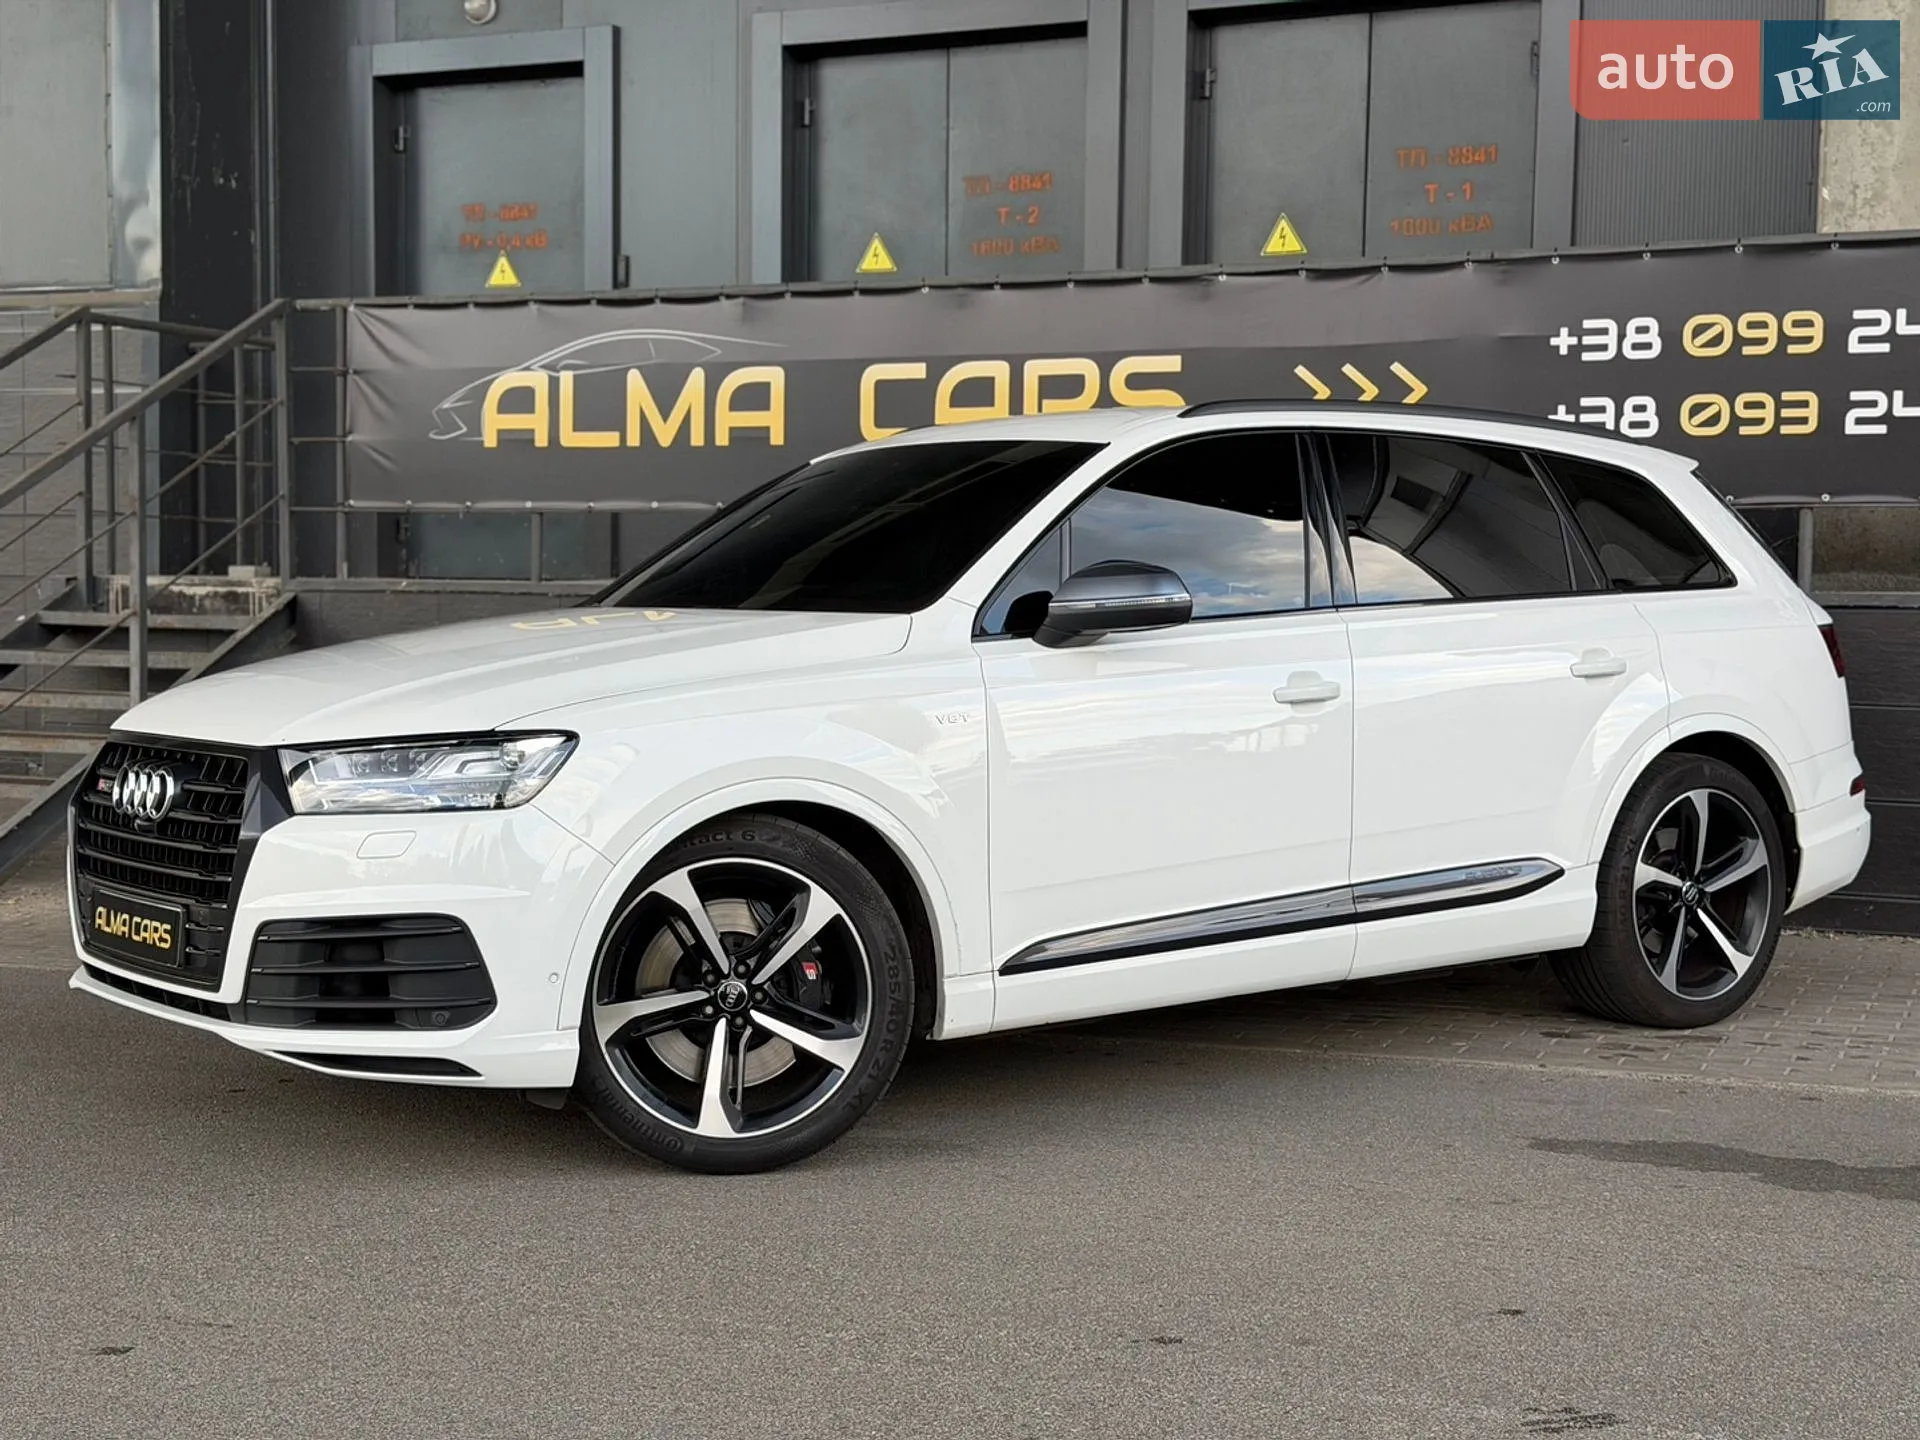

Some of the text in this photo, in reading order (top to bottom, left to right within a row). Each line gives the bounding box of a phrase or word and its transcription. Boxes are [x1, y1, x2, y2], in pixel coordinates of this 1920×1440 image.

[1027, 206, 1040, 226] 2
[1550, 317, 1662, 361] +38
[1682, 310, 1824, 358] 099
[482, 354, 1187, 448] ALMA CARS
[1679, 390, 1819, 436] 093
[95, 906, 172, 949] ALMA CARS
